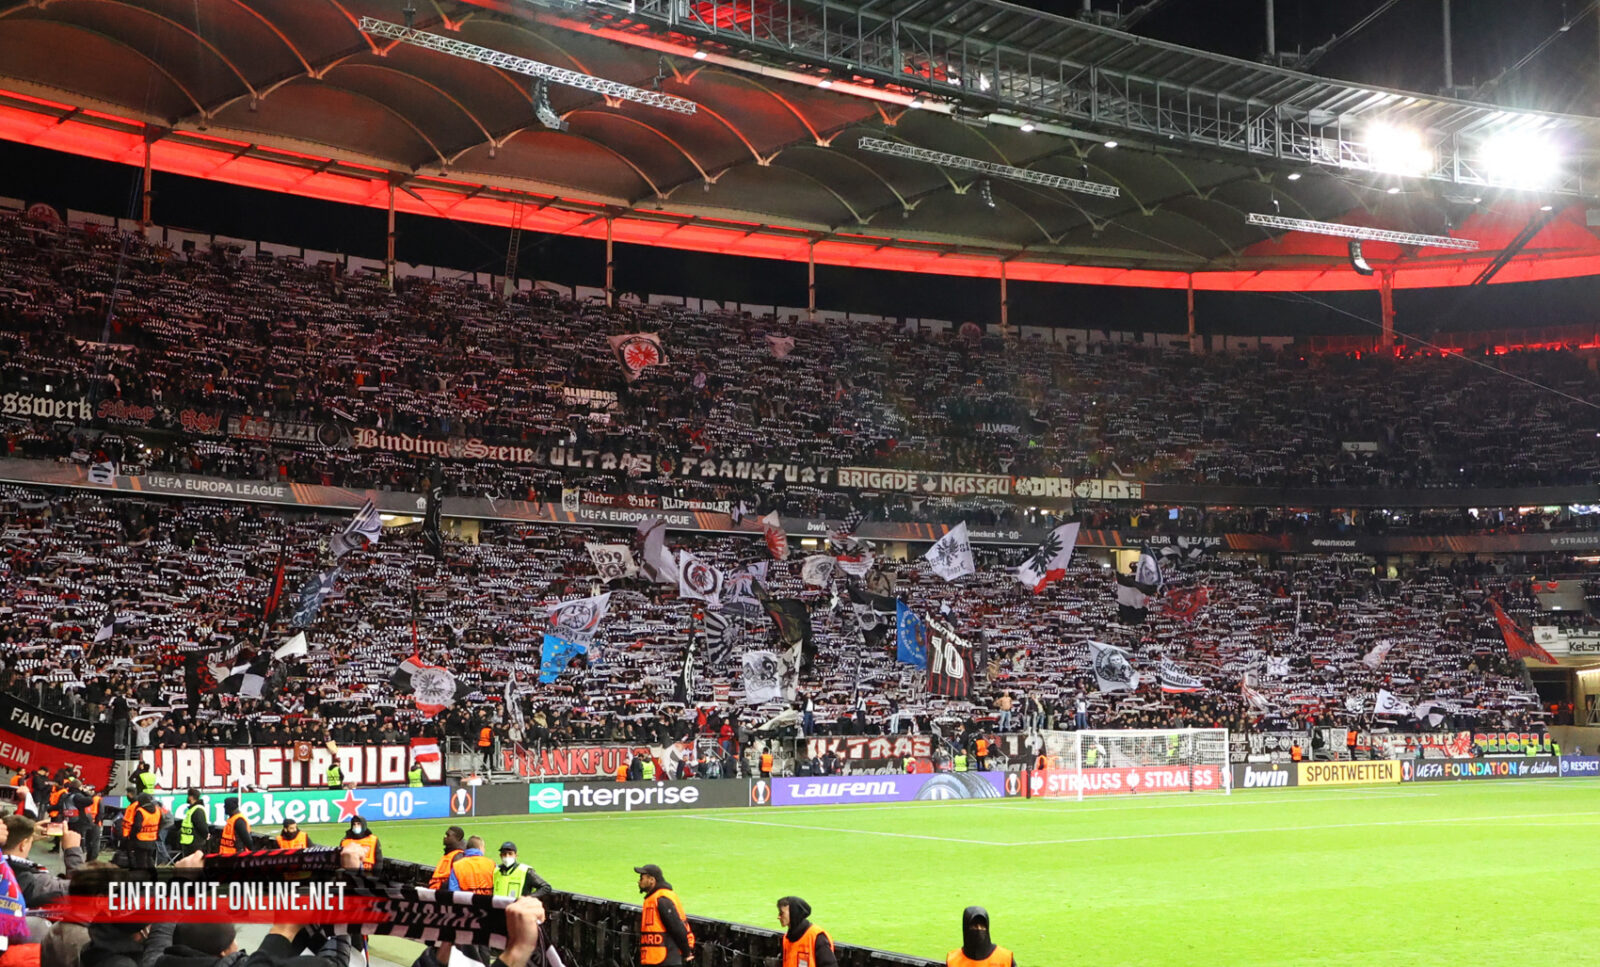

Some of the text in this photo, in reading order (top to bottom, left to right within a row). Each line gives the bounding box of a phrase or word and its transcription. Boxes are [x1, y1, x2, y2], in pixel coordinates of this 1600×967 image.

[0, 392, 93, 420] sswerk
[353, 427, 534, 463] Binding Szene
[550, 447, 834, 484] ULTRAS FRANKFURT
[148, 475, 285, 497] UEFA EUROPA LEAGUE
[838, 470, 1010, 495] BRIGADE NASSAU
[580, 509, 607, 520] UEFA
[610, 511, 648, 521] EUROPA
[661, 496, 731, 513] KLIPPENADLER
[1560, 536, 1599, 545] STRAUSS
[931, 635, 964, 679] 10
[10, 707, 96, 745] FAN-CLUB
[0, 741, 30, 765] EIM
[1243, 764, 1289, 788] bwin
[1306, 763, 1393, 782] SPORTWETTEN
[1416, 761, 1558, 777] UEFA FOUNDATION for children
[1570, 761, 1599, 771] RESPECT
[1048, 768, 1213, 792] STRAUSS STRAUSS
[382, 790, 414, 817] 0.0
[531, 781, 700, 812] enterprise
